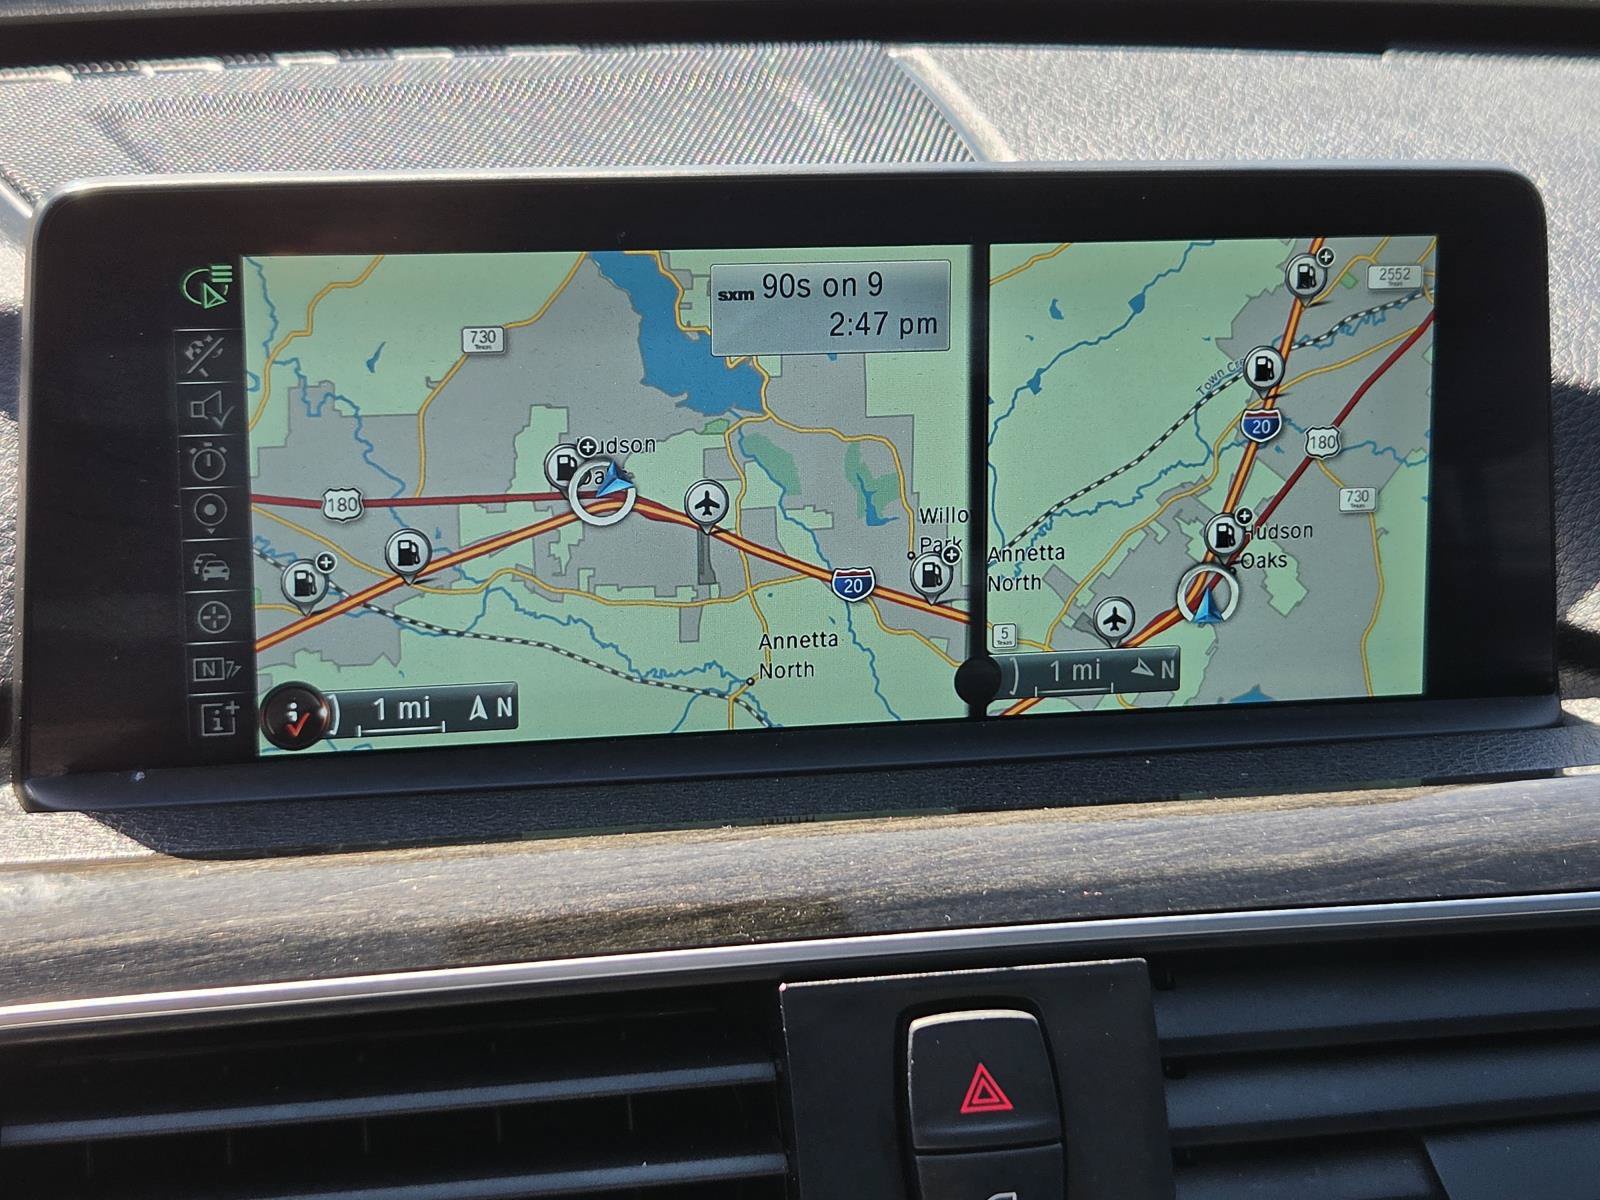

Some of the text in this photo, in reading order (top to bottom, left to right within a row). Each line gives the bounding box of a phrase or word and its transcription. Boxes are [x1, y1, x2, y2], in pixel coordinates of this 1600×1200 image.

[1379, 267, 1411, 280] 2552
[717, 271, 883, 301] sxm 90s on 9
[829, 311, 938, 340] 2:47 pm
[470, 329, 497, 344] 730
[1195, 369, 1225, 396] Town
[1252, 419, 1271, 434] 20
[1310, 435, 1336, 449] 180
[327, 497, 358, 512] 180
[1346, 489, 1370, 503] 730
[919, 506, 973, 525] Willo
[987, 545, 1065, 563] Annetta
[1240, 551, 1288, 570] Oaks
[844, 578, 863, 593] 20
[988, 573, 1042, 592] North
[758, 631, 838, 650] Annetta
[1001, 626, 1009, 640] 5
[760, 661, 814, 680] North
[1050, 658, 1175, 682] 1 mi N
[373, 695, 513, 721] 1 mi N
